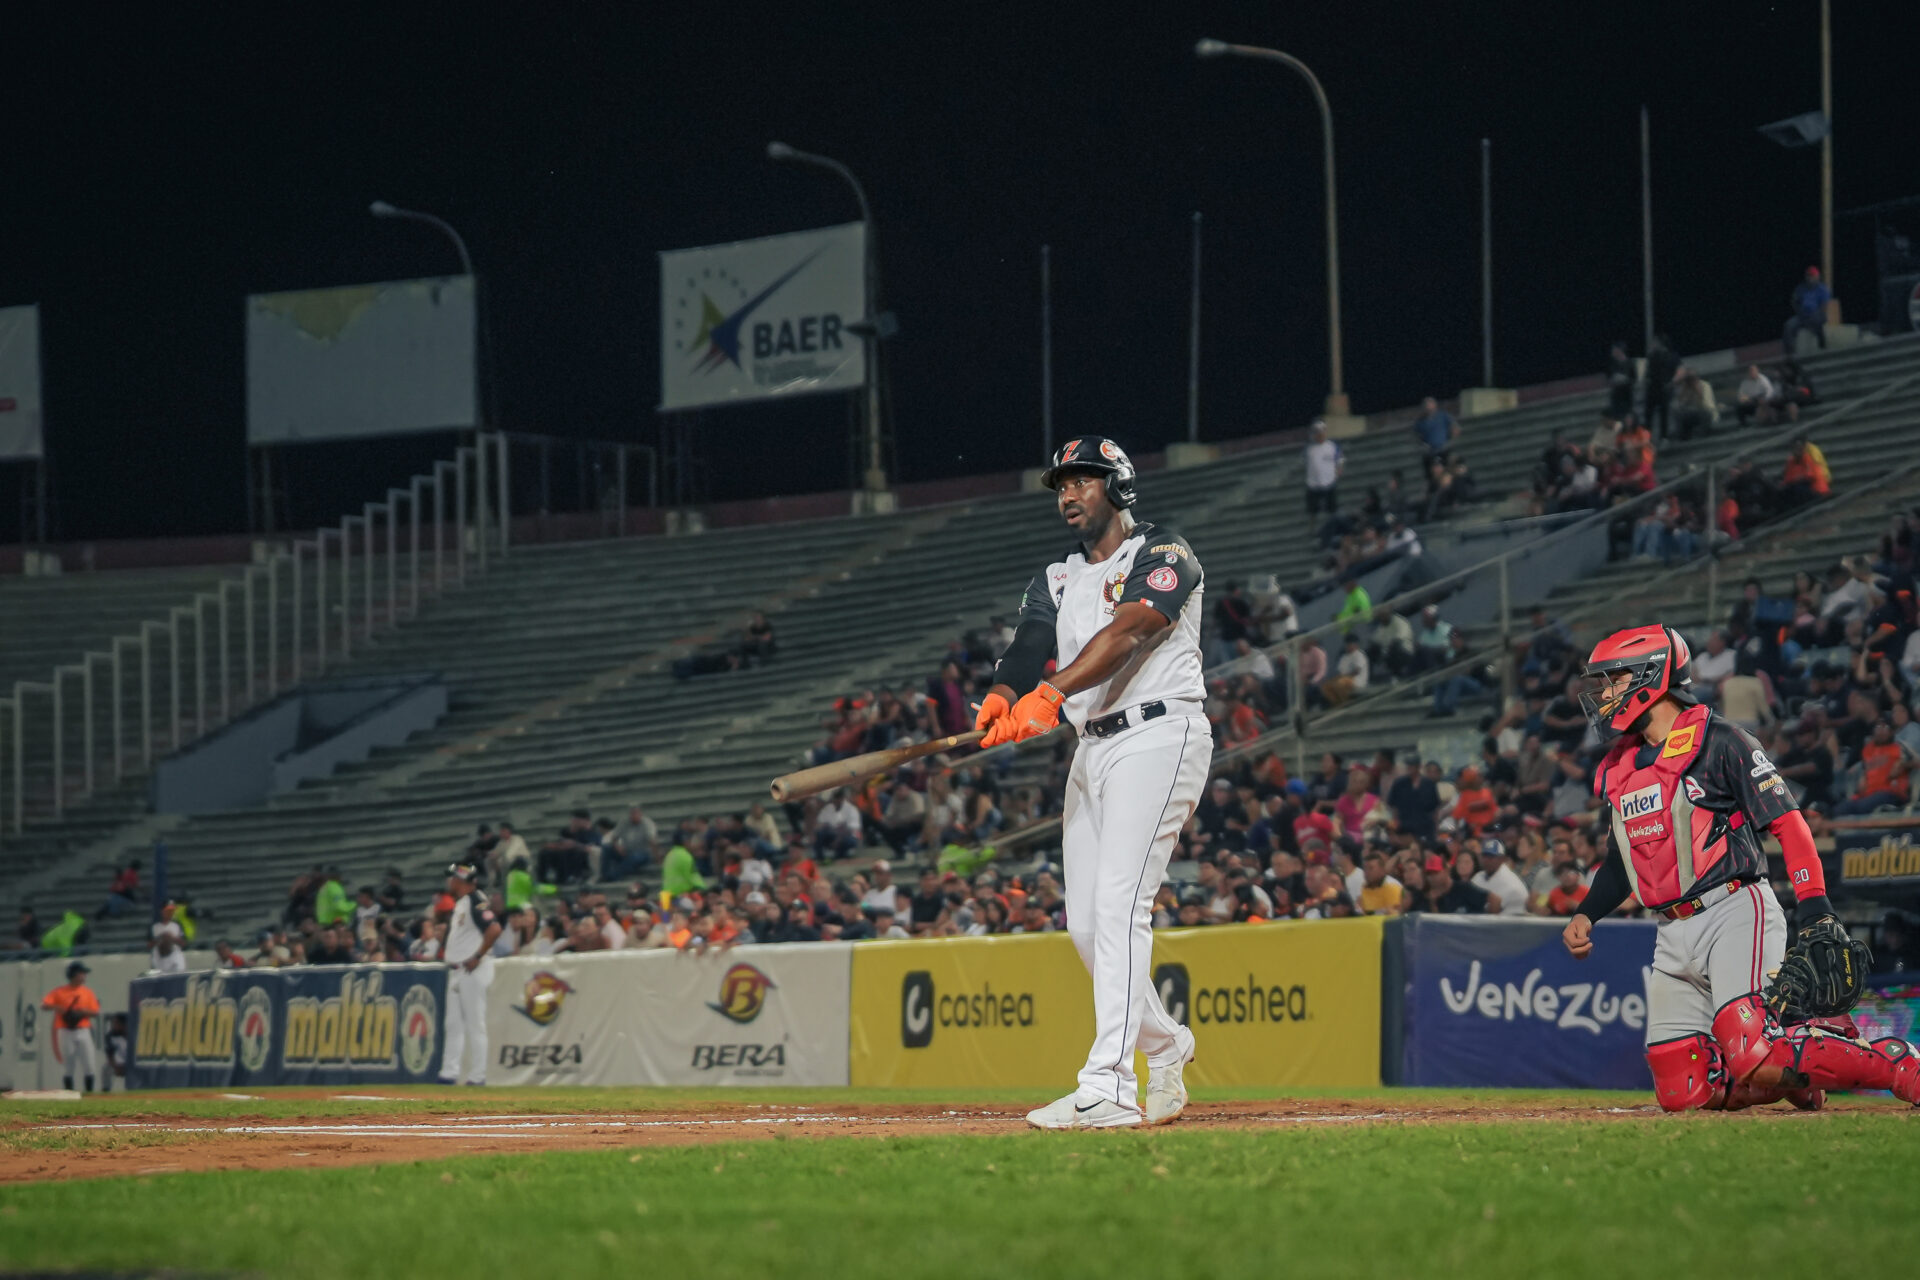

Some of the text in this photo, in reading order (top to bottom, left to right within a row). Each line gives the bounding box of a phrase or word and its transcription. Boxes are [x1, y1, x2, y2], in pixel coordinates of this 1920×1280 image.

[753, 313, 844, 360] BAER
[1622, 793, 1659, 817] inter
[1793, 868, 1810, 884] 20
[1841, 832, 1920, 883] maltin
[1691, 898, 1702, 909] 20
[135, 970, 237, 1067] maltin
[284, 970, 398, 1069] maltin
[938, 982, 1034, 1027] cashea
[1197, 973, 1307, 1024] cashea
[499, 1043, 583, 1068] BERA
[691, 1043, 785, 1070] BERA
